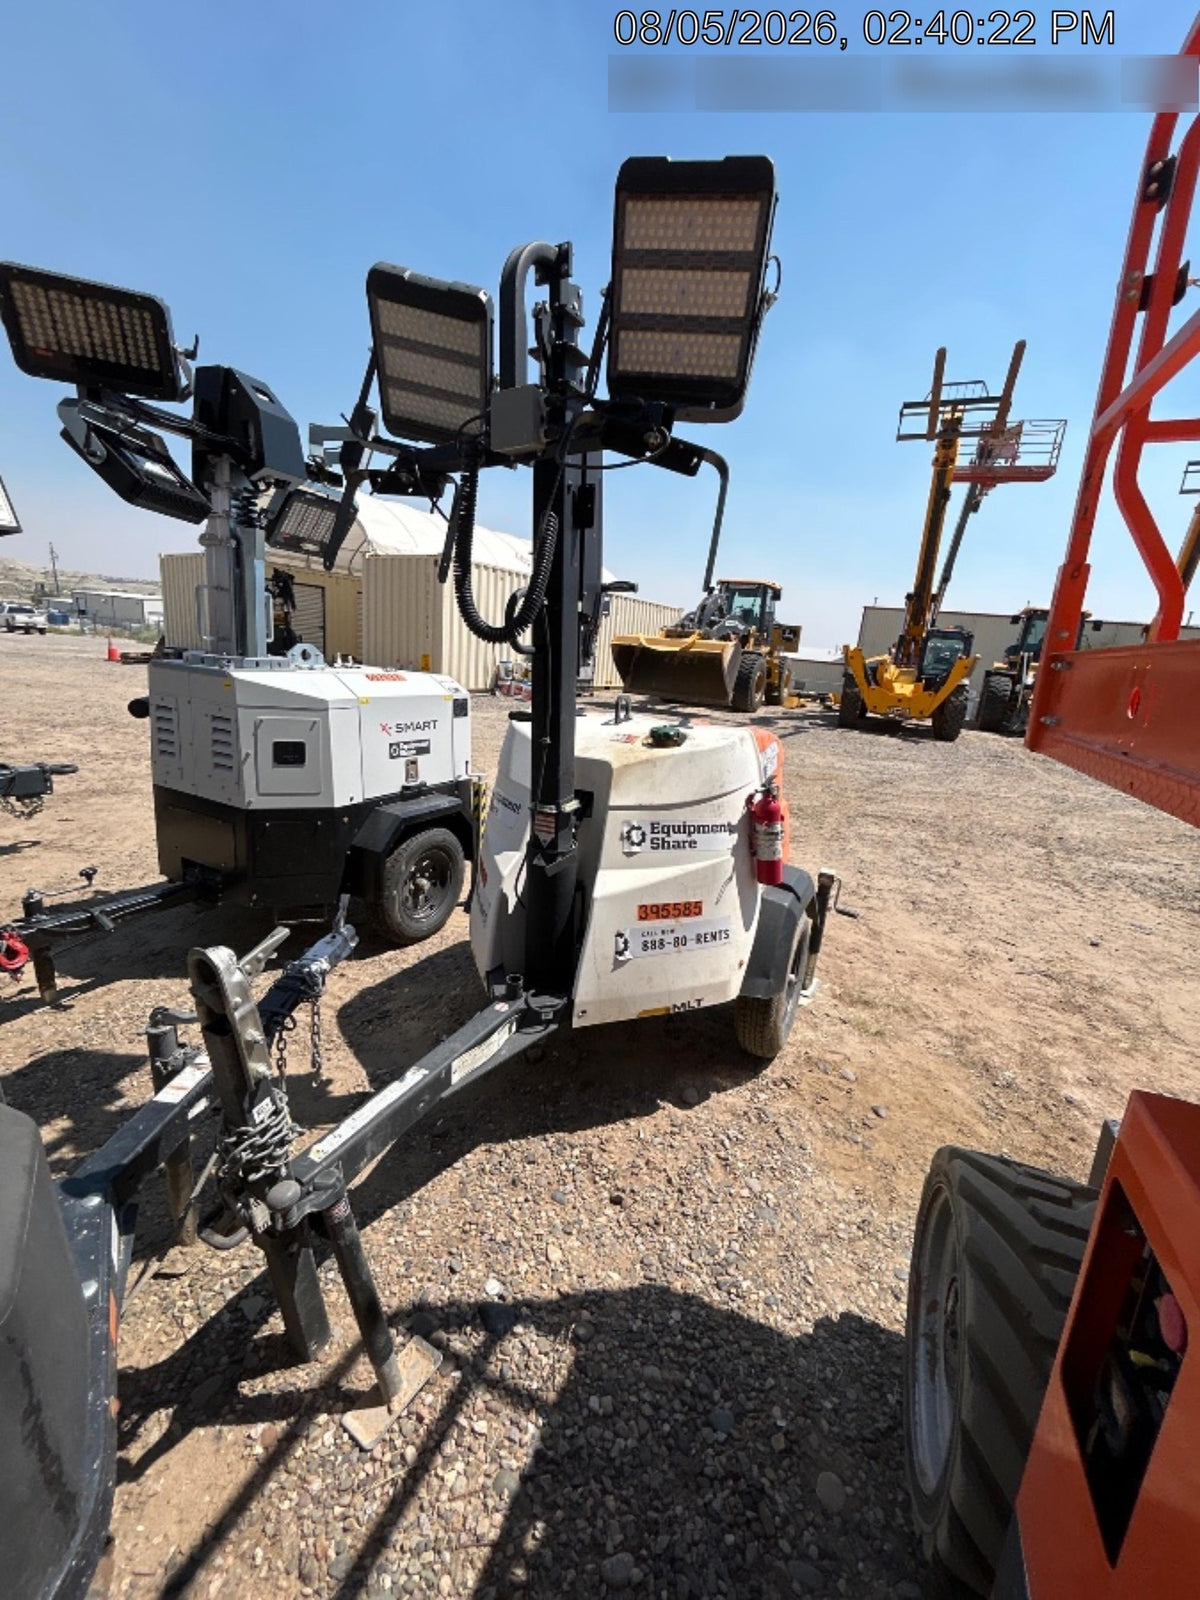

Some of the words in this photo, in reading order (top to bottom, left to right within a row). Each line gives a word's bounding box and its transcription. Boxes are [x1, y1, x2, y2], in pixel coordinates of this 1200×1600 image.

[650, 837, 698, 850] Share
[638, 901, 703, 920] 395585
[672, 997, 704, 1012] MLT
